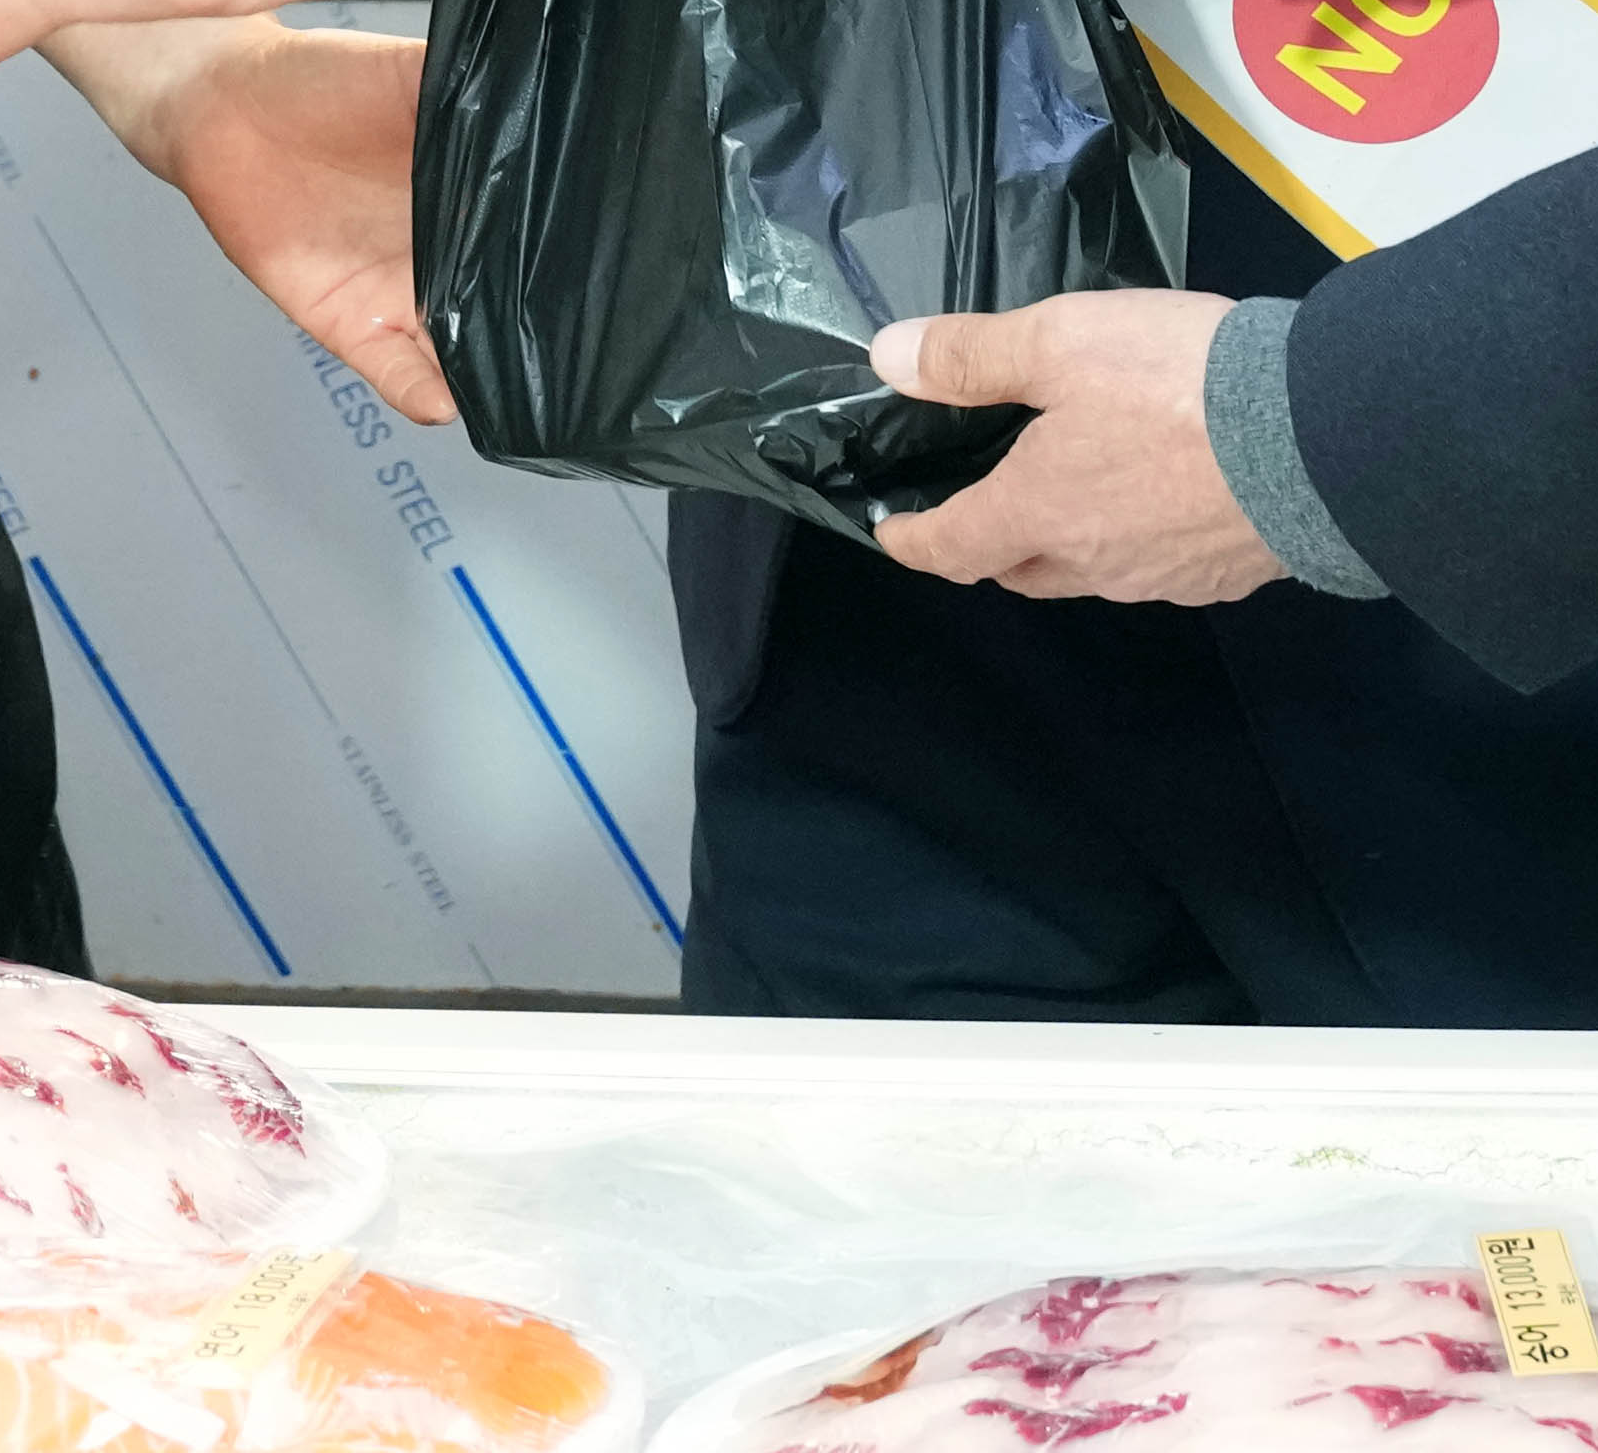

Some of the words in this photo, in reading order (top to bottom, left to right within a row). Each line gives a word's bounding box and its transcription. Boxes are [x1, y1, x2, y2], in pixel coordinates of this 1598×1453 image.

[377, 460, 454, 563] STEEL
[407, 851, 456, 916] STEEL
[1485, 1237, 1549, 1312] 13,000원
[1512, 1323, 1570, 1364] 송어
